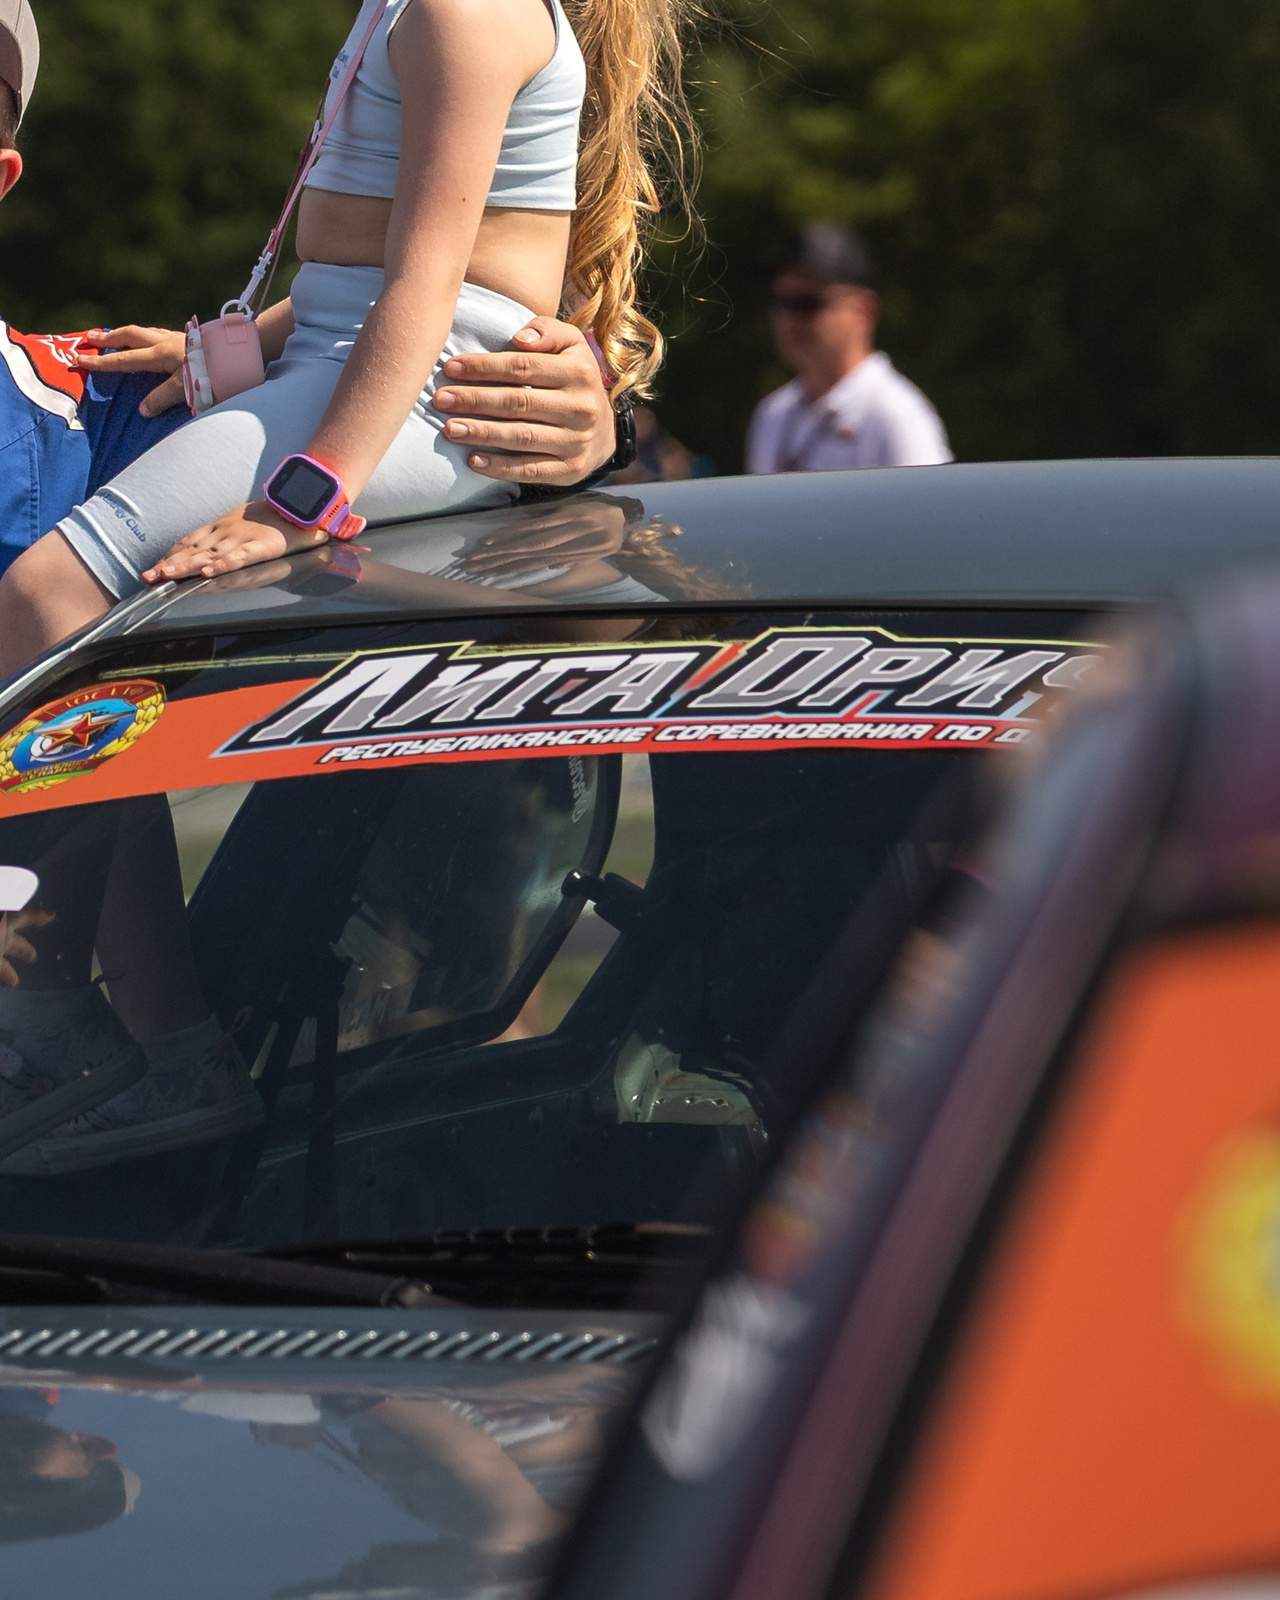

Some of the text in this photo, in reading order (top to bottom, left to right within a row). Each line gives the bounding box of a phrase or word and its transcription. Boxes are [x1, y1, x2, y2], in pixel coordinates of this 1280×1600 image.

[125, 518, 146, 542] Club
[320, 726, 653, 764] РЕСПУБЛИКАНСКИЕ
[655, 723, 924, 742] СОРЕВНОВАНИЯ
[935, 725, 993, 742] ПО
